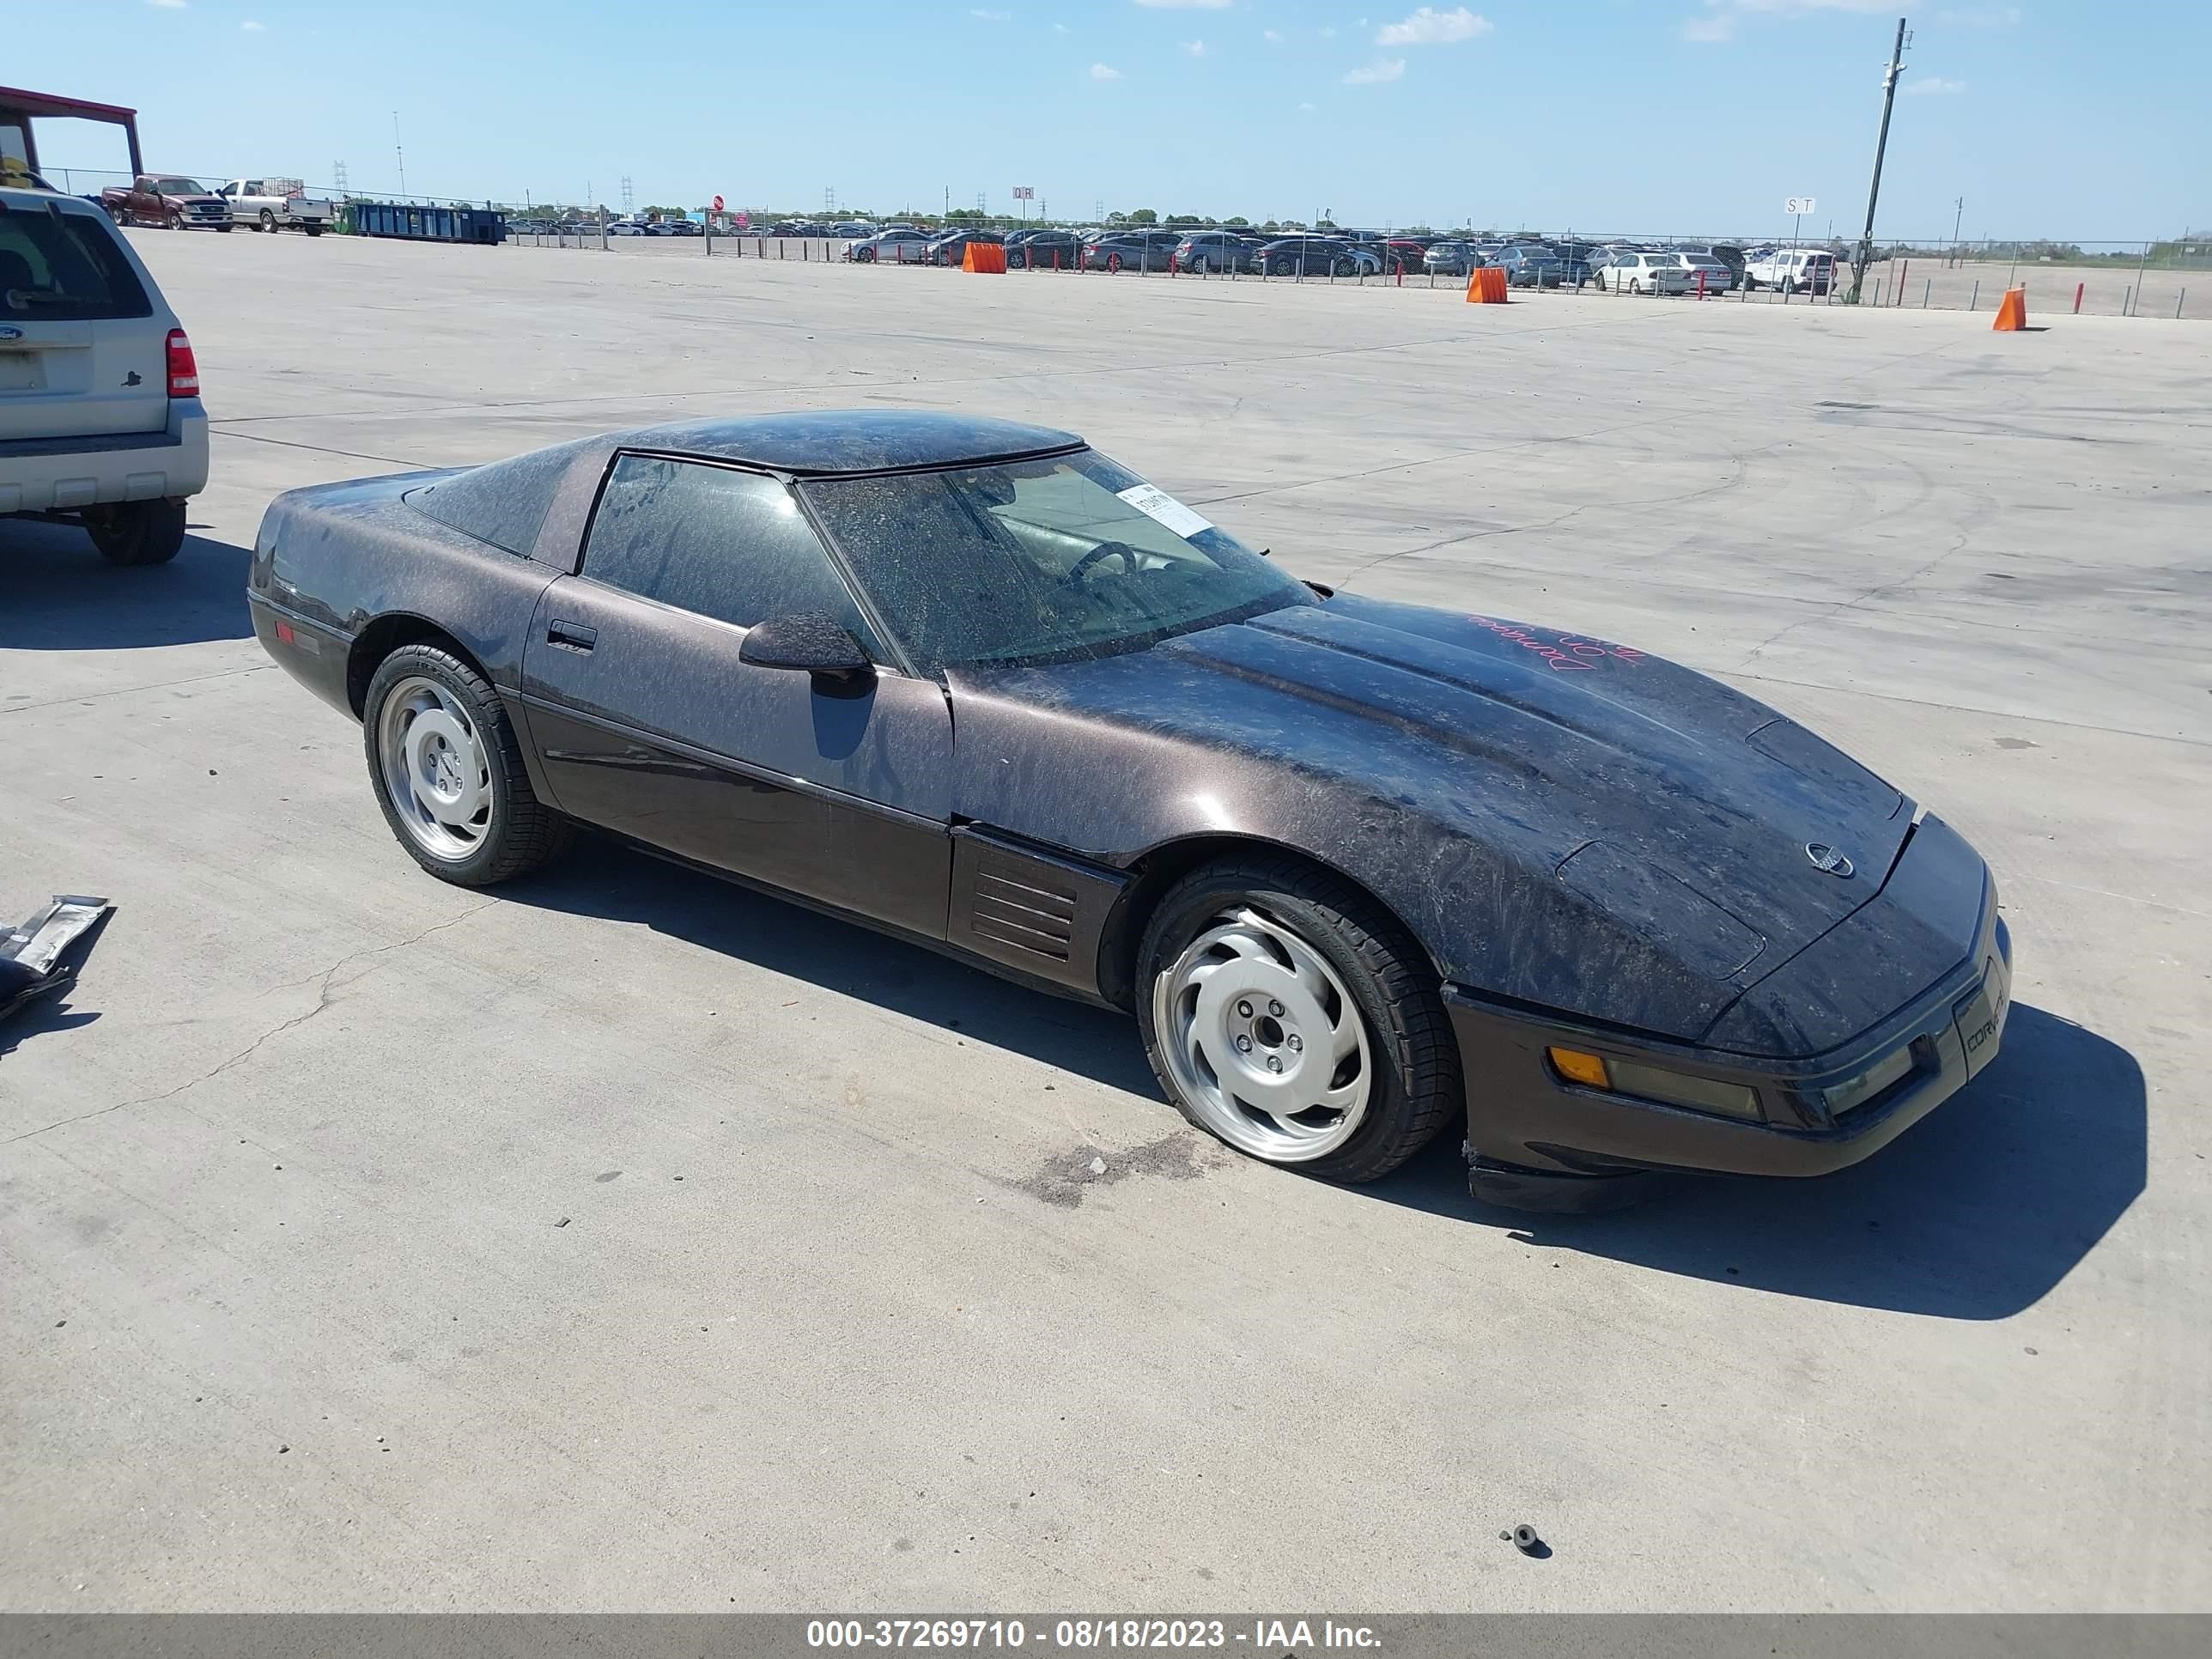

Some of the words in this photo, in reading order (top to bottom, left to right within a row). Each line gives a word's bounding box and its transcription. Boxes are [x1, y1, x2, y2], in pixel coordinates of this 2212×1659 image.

[1025, 187, 1031, 198] R
[1788, 198, 1796, 212] S
[1804, 198, 1813, 212] T
[1468, 617, 1597, 672] Damage
[1559, 636, 1606, 657] On
